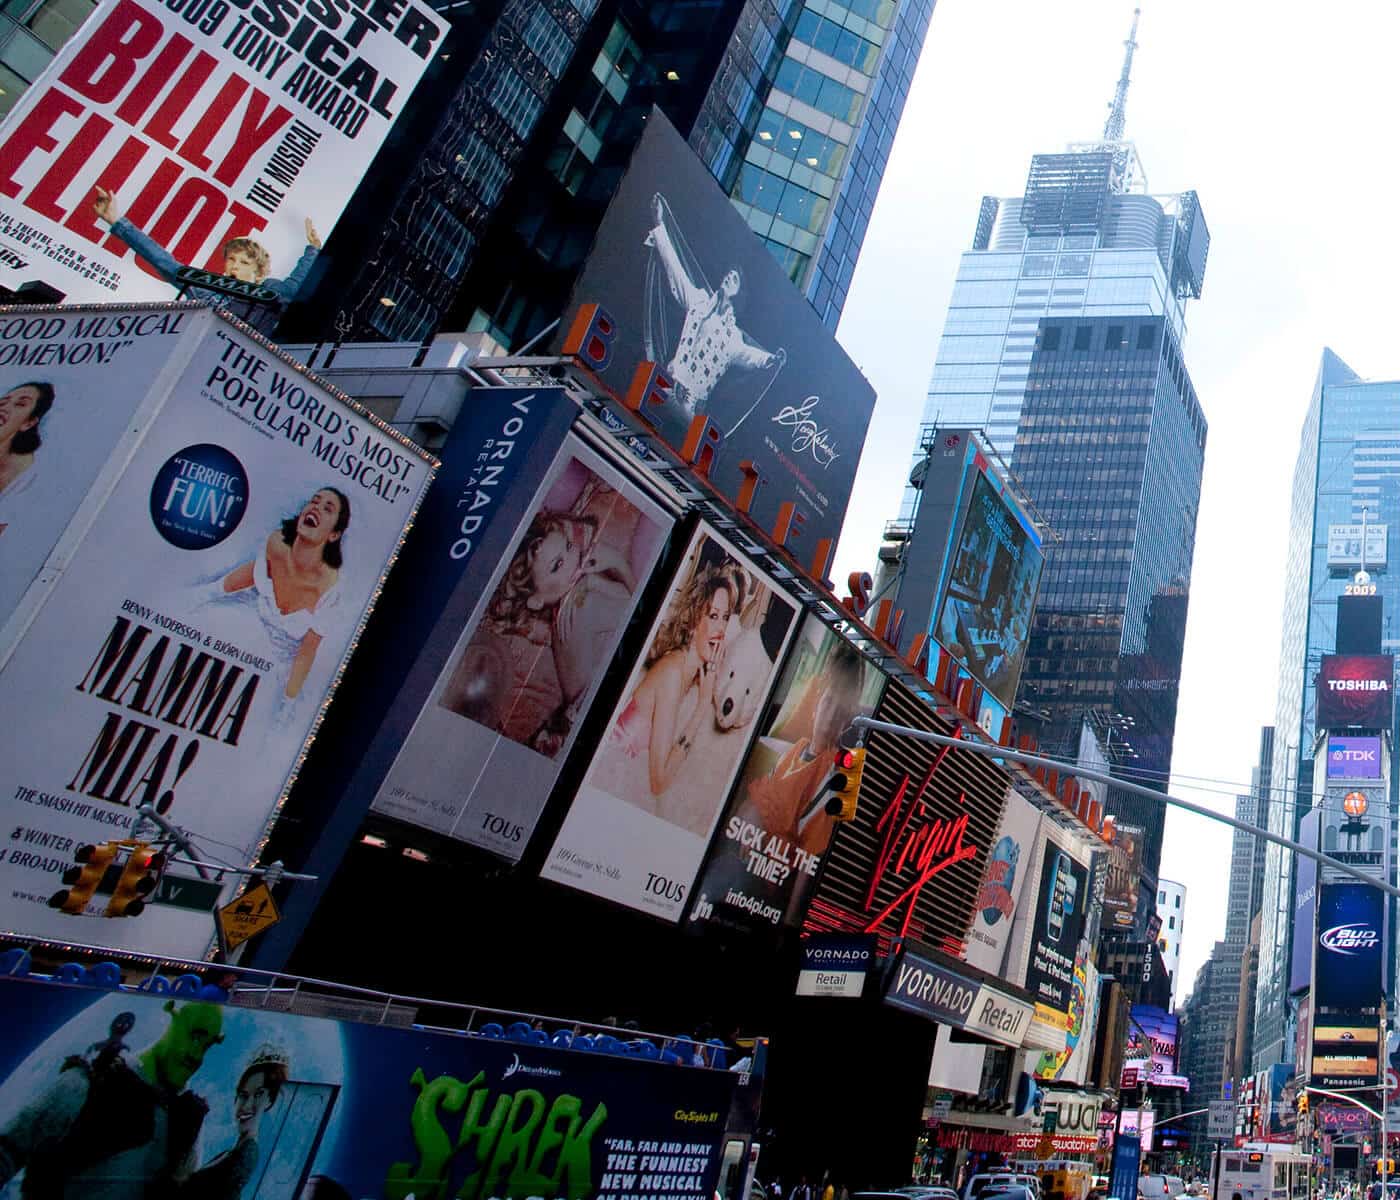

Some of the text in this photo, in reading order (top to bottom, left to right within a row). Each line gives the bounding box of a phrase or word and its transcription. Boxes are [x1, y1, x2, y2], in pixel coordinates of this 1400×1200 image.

[222, 14, 370, 140] TONY AWARD
[228, 0, 398, 121] SICAL
[58, 0, 294, 188] BILLY
[0, 86, 269, 284] ELLIOT
[246, 119, 322, 214] THE MUSICAL
[43, 246, 119, 291] Telecharge.com
[184, 269, 270, 299] LAMAR
[68, 312, 185, 339] MUSICAL
[205, 365, 313, 449] POPULAR
[360, 434, 417, 482] MOST
[457, 438, 495, 509] RETAIL
[449, 393, 537, 561] VORNADO
[1344, 584, 1377, 596] 2009
[121, 599, 153, 621] BENNY
[202, 635, 213, 647] &
[75, 615, 261, 747] MAMMA
[1327, 679, 1389, 691] TOSHIBA
[65, 711, 201, 816] MIA!
[1343, 750, 1376, 761] TDK
[14, 786, 133, 829] THE SMASH HIT MUSICAL
[24, 828, 74, 854] WINTER
[482, 812, 525, 843] TOUS
[9, 849, 80, 874] BROADW
[725, 816, 822, 877] SICK ALL THE
[746, 850, 791, 886] TIME?
[645, 872, 687, 904] TOUS
[725, 887, 782, 924] info4pi.org
[1329, 937, 1380, 948] LIGHT
[1335, 929, 1376, 939] BUD
[806, 948, 869, 959] VORNADO
[1143, 943, 1153, 982] 1500
[816, 972, 848, 985] Retail
[896, 963, 974, 1016] VORNADO
[979, 997, 1024, 1036] Retail
[1323, 1077, 1366, 1086] Panasonic
[382, 1066, 609, 1200] SHREK
[637, 1140, 658, 1154] FAR
[658, 1142, 682, 1155] AND
[682, 1143, 712, 1156] AWAY
[600, 1174, 703, 1192] NEW MUSICAL
[607, 1155, 709, 1174] THE FUNNIEST
